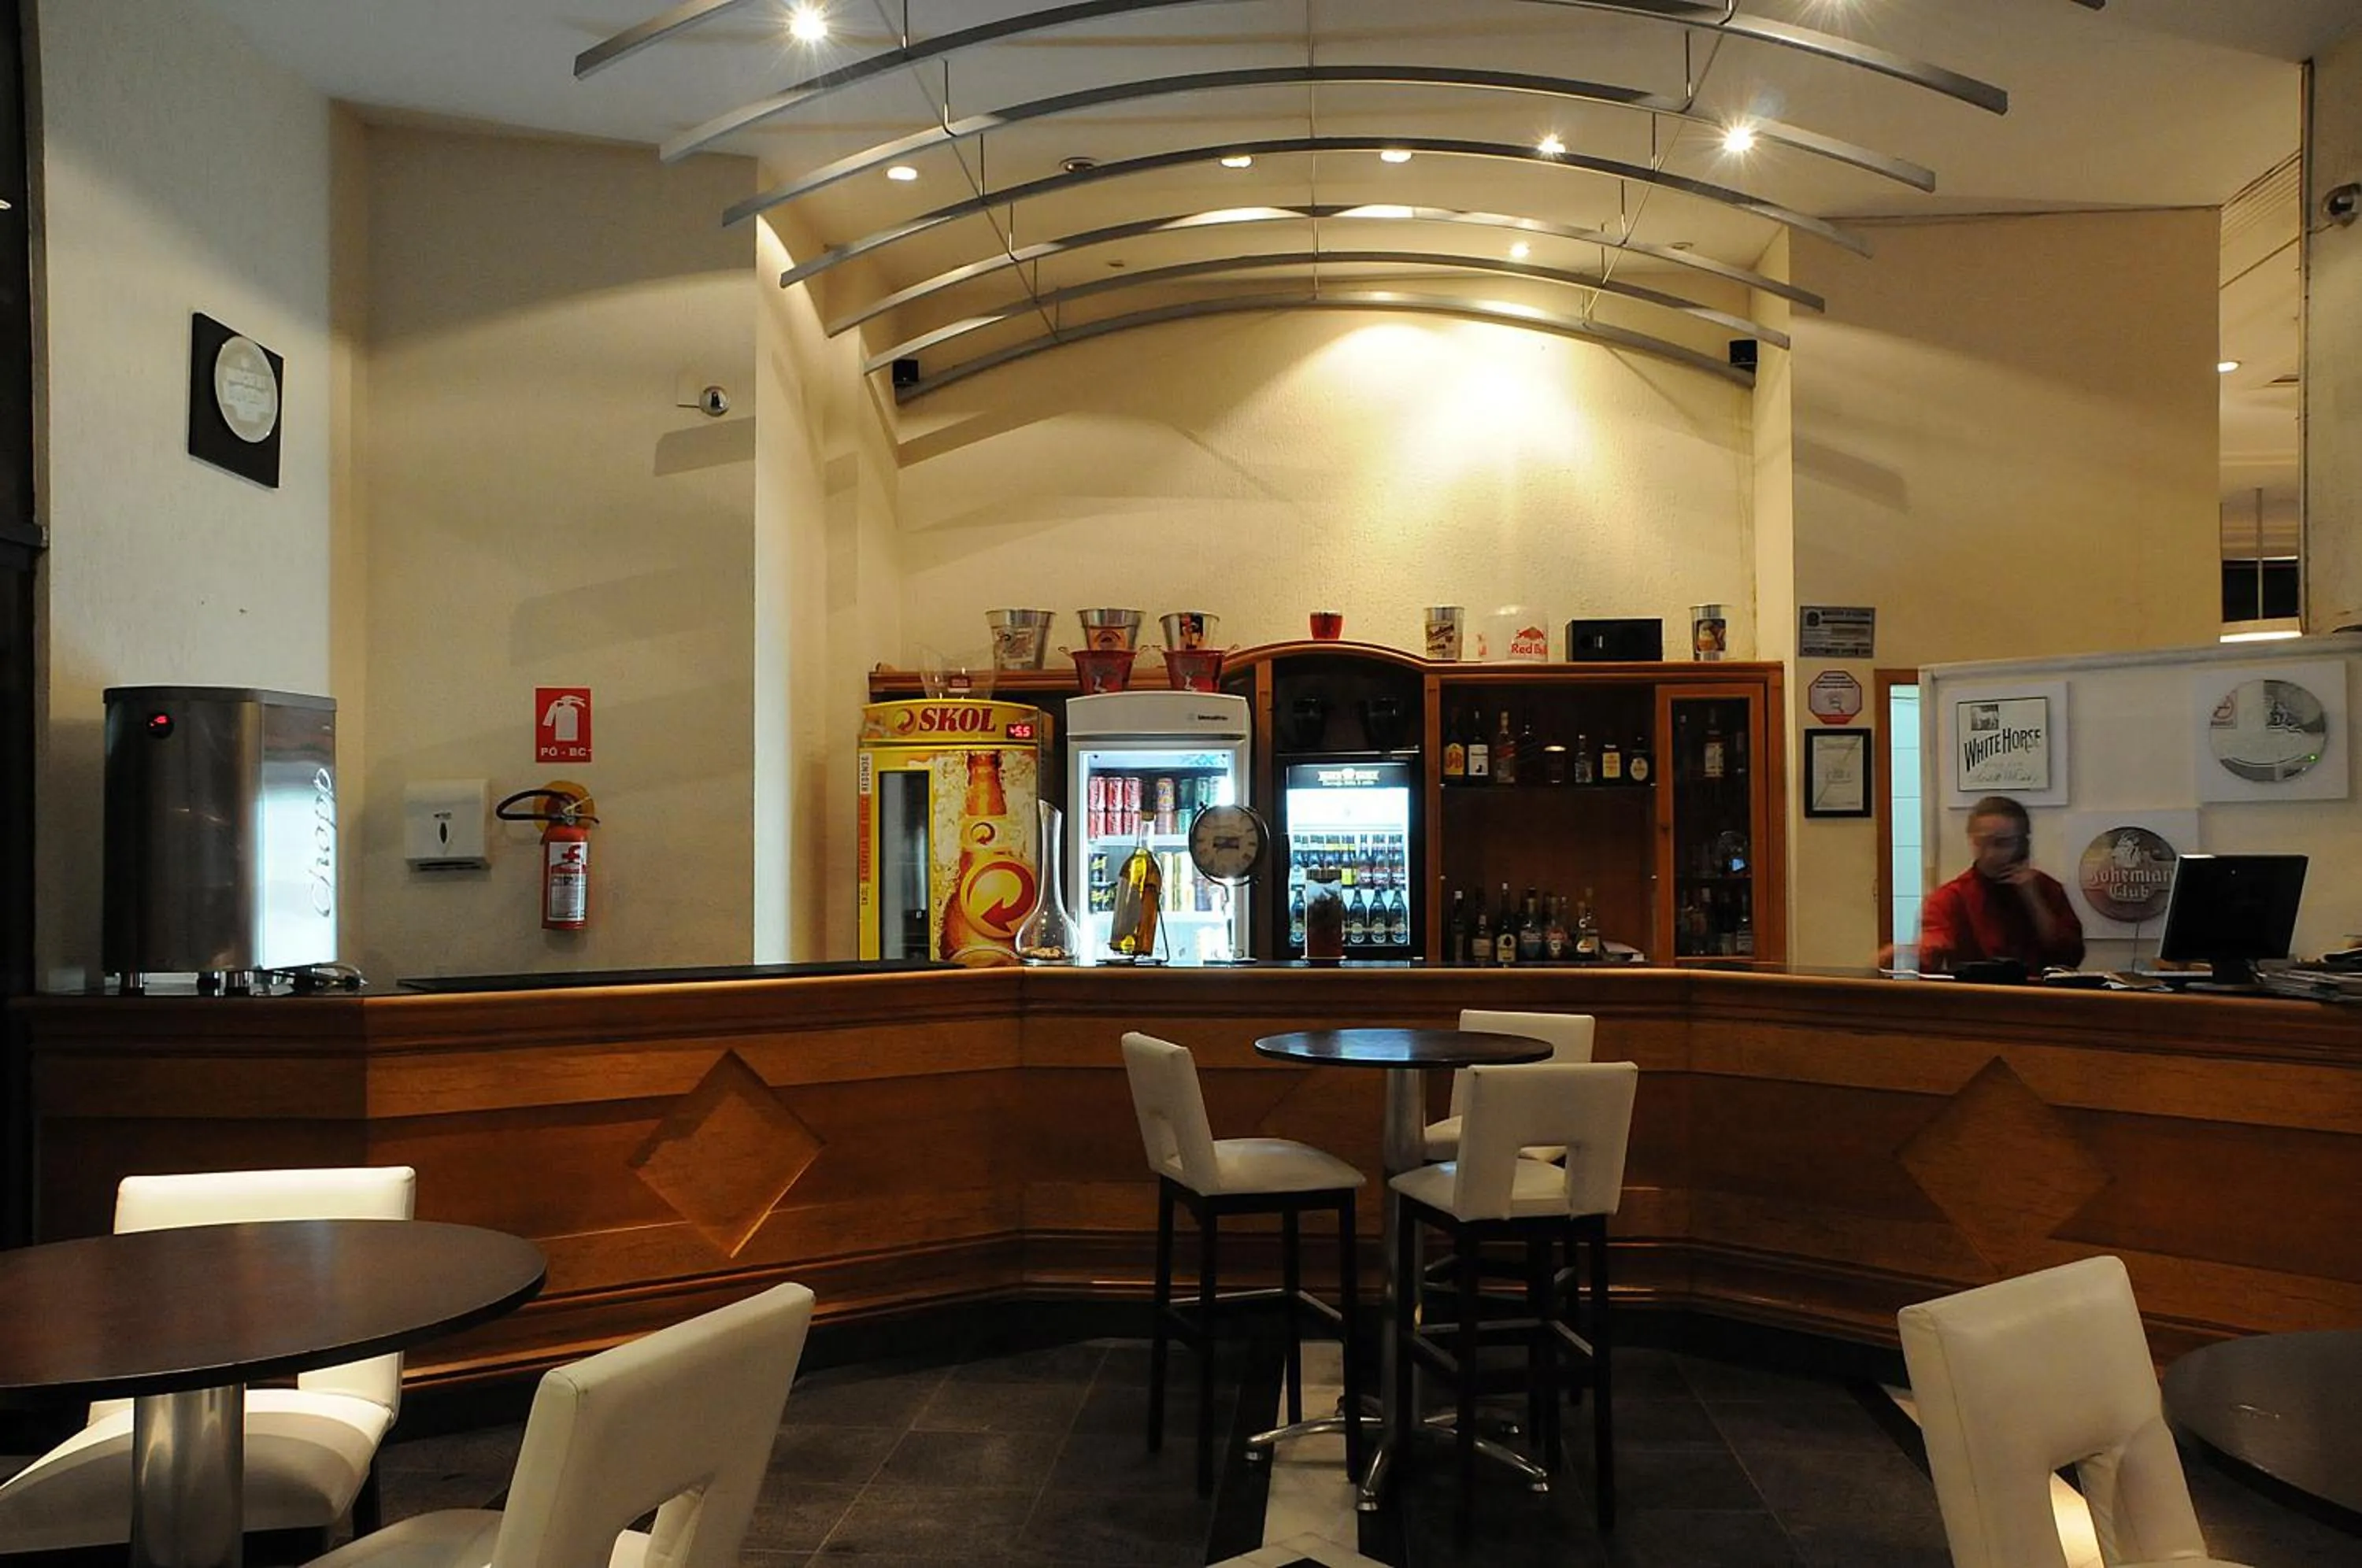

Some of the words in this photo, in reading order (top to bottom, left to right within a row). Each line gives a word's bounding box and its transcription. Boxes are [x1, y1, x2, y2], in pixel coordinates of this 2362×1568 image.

[1512, 642, 1533, 654] Red
[919, 707, 996, 732] SKOL
[1964, 733, 2001, 772] WHITE
[2002, 727, 2041, 753] HORSE
